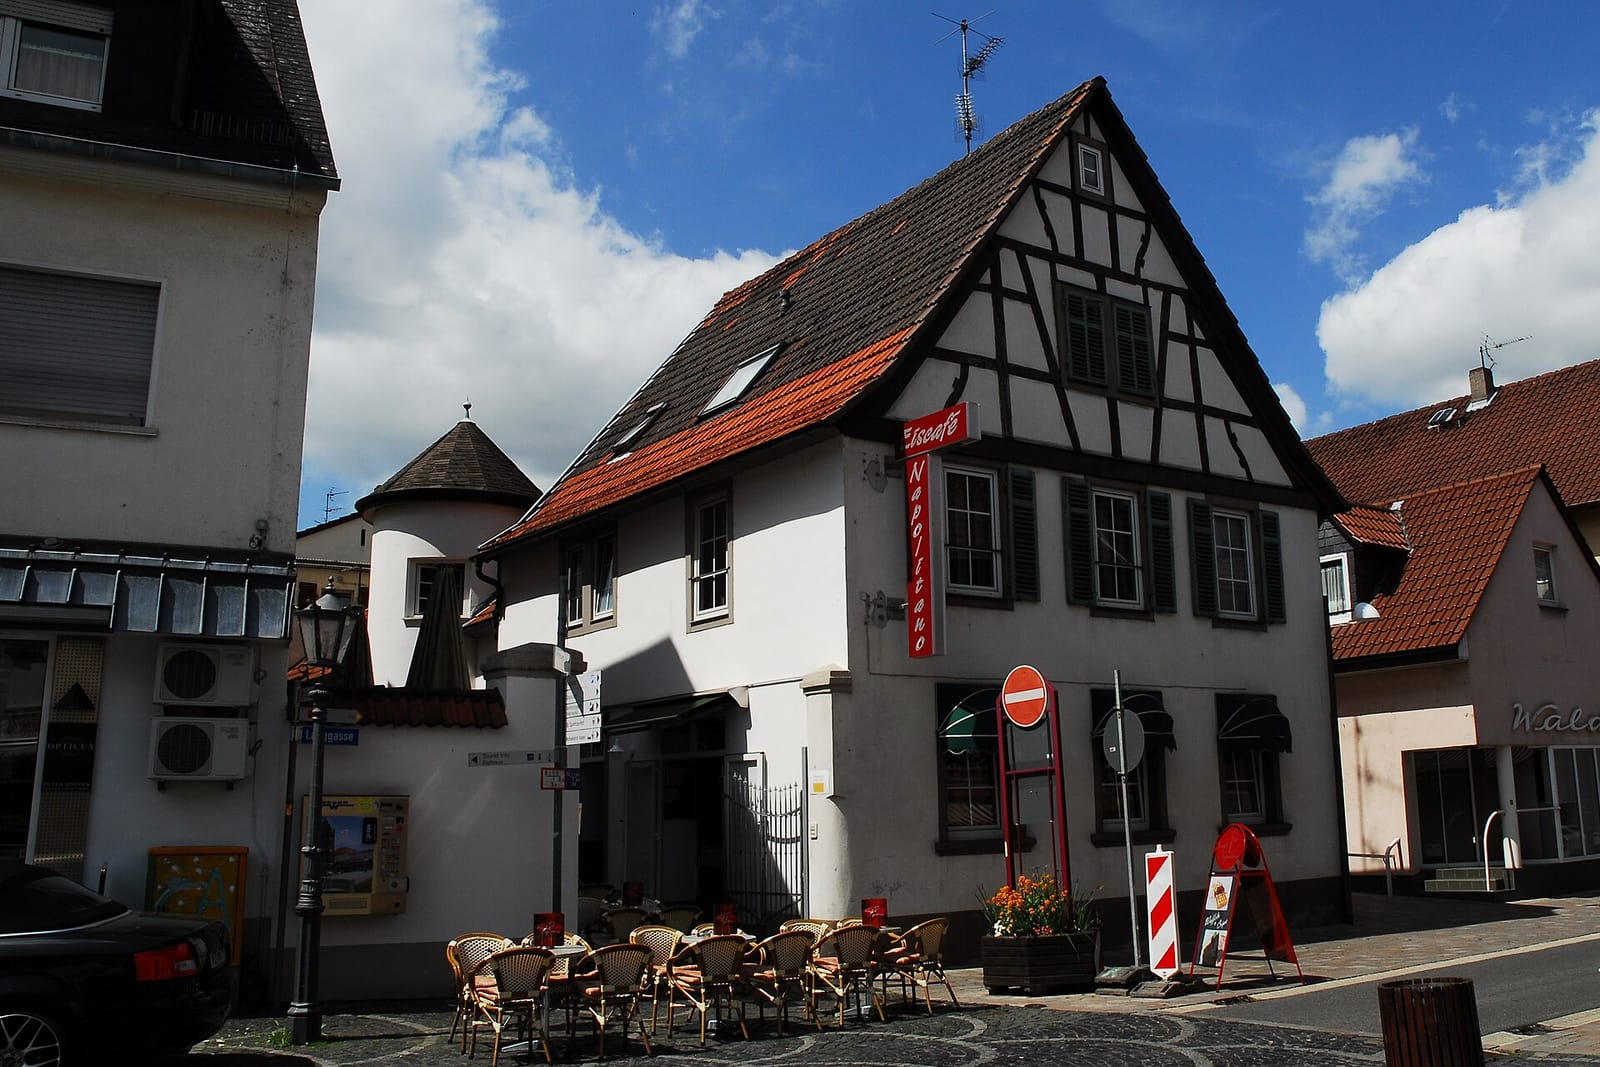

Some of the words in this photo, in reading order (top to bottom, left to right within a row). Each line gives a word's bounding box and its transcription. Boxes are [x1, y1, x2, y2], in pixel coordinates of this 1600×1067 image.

[909, 460, 926, 652] Napolitano
[305, 728, 354, 743] Lgasse
[47, 743, 95, 751] OPTICUS
